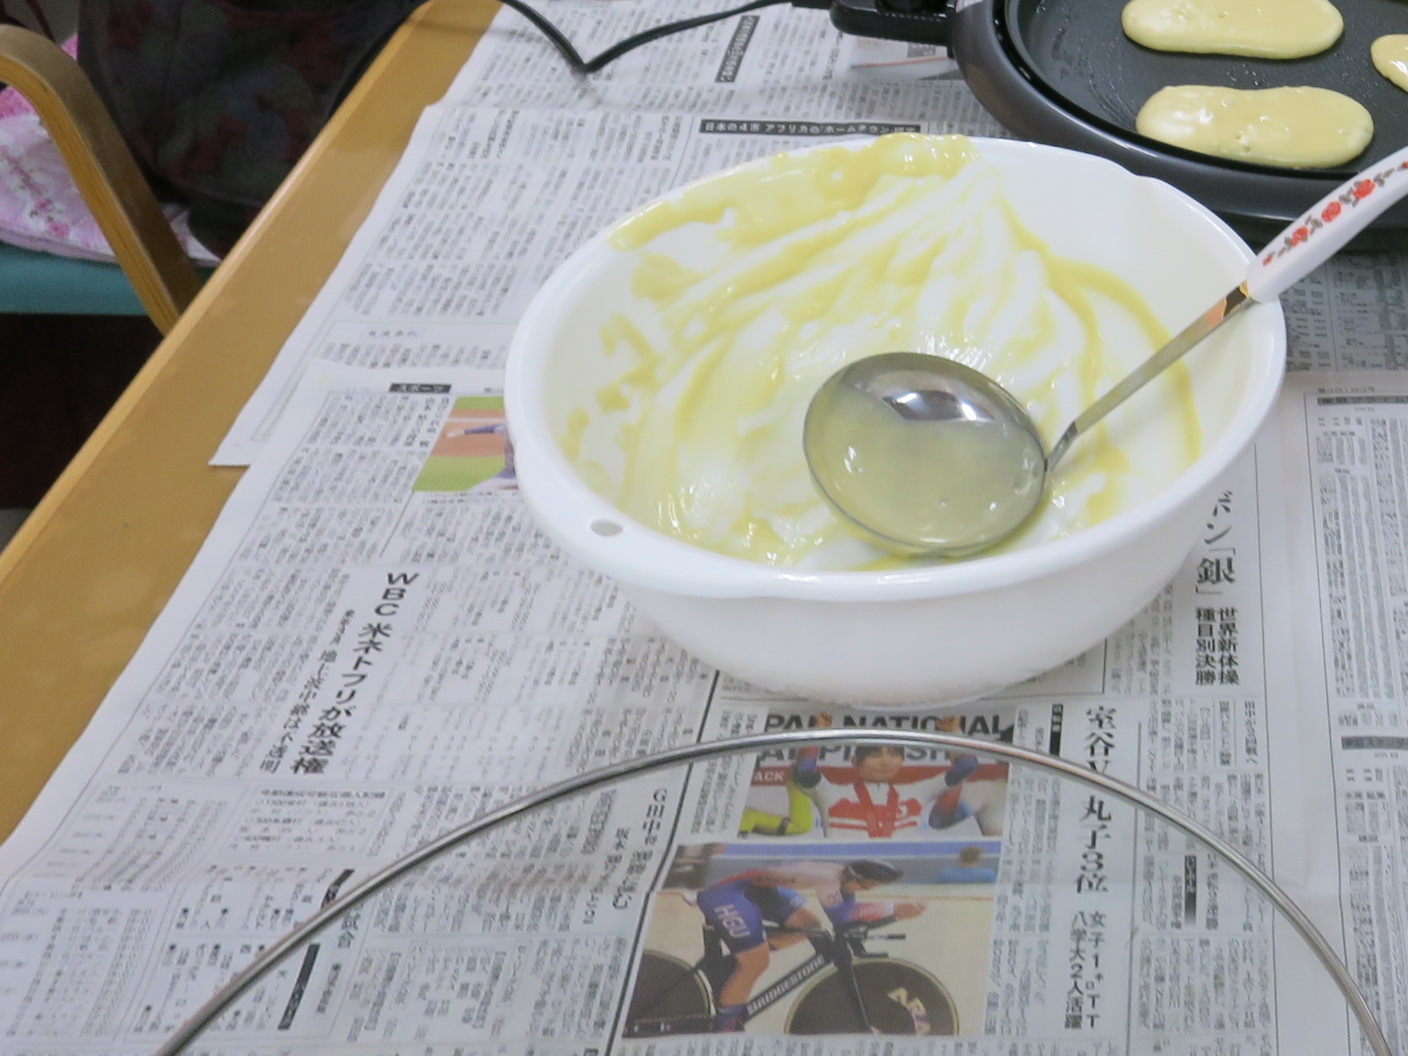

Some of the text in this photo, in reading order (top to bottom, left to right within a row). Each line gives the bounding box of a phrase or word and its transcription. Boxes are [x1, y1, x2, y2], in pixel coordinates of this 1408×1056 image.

[374, 572, 420, 616] WBC
[1195, 606, 1217, 686] 種目別決勝
[1218, 606, 1239, 686] 世界新体操
